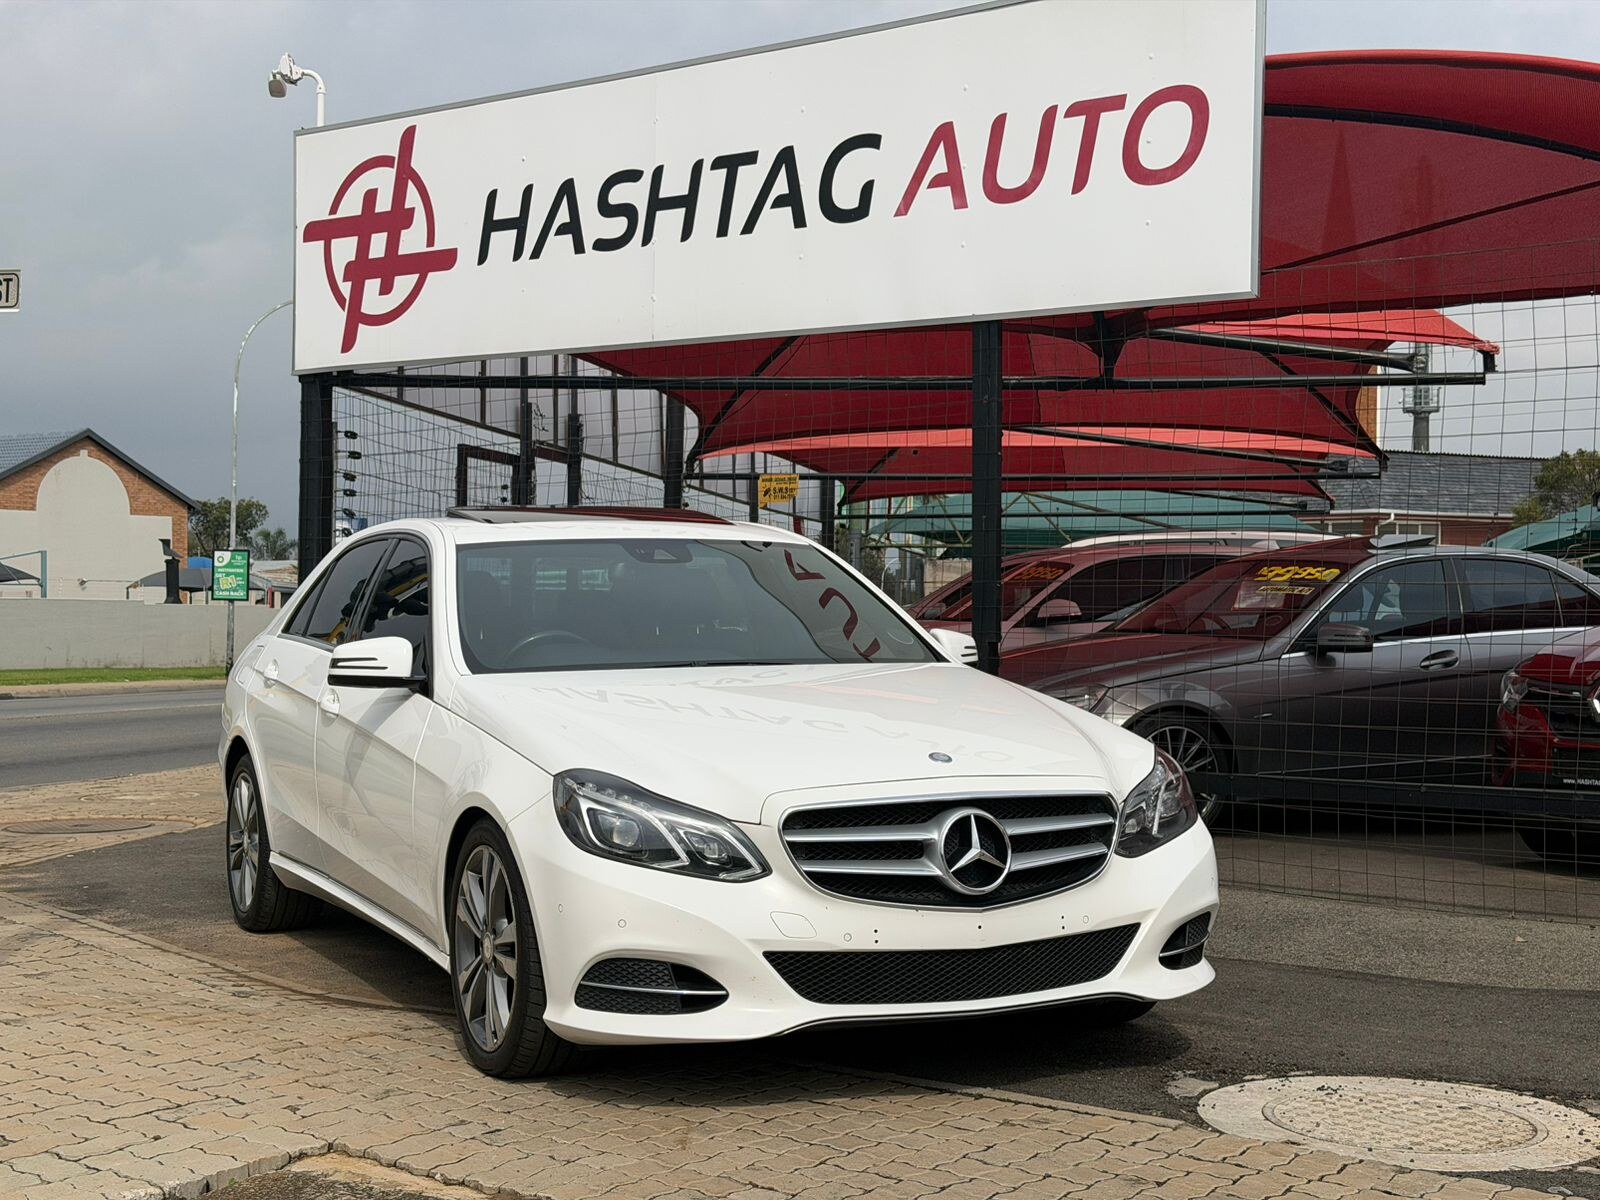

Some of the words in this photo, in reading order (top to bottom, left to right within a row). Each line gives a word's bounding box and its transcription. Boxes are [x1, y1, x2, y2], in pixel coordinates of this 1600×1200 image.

[477, 133, 882, 267] HASHTAG
[893, 84, 1210, 218] AUTO
[0, 278, 13, 304] T
